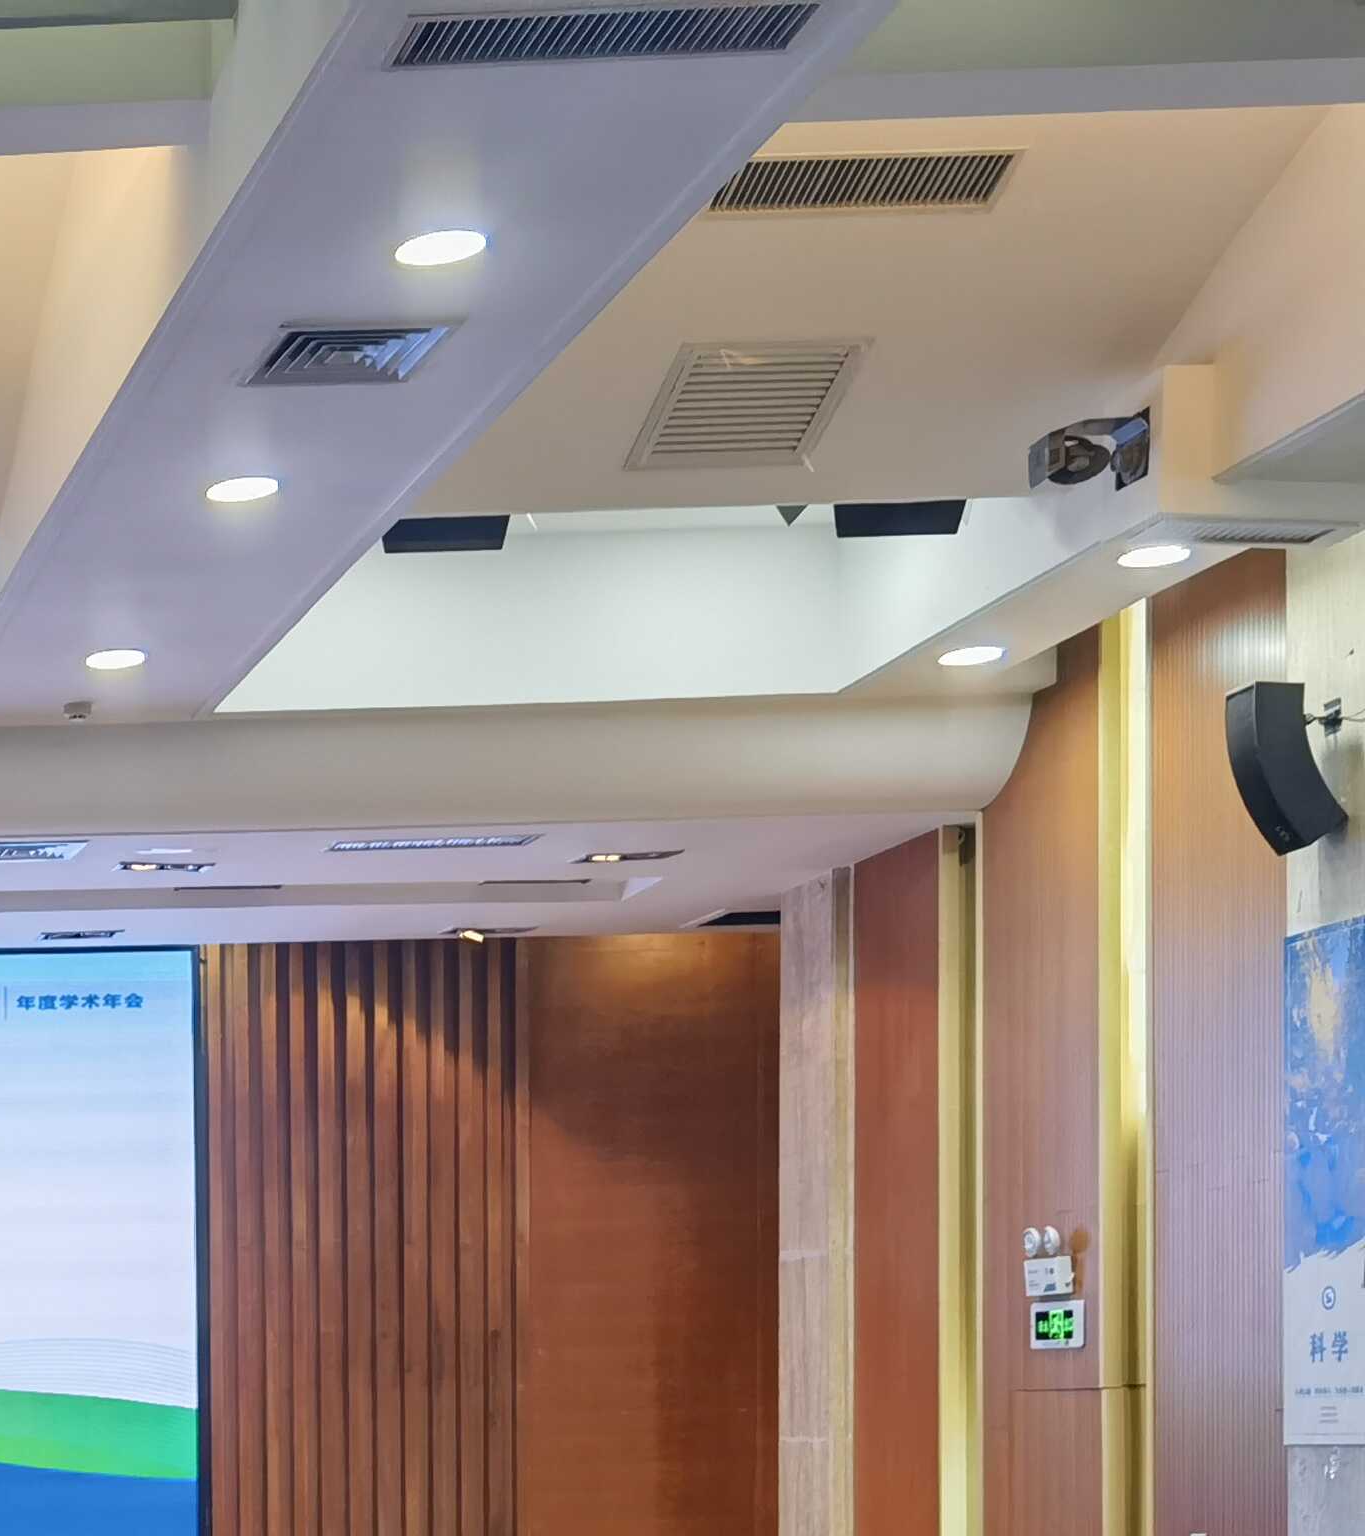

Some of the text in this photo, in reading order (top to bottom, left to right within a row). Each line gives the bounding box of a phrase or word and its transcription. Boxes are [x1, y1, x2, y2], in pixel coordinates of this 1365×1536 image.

[16, 992, 143, 1010] 年度学术年会
[1309, 1330, 1350, 1364] 科学
